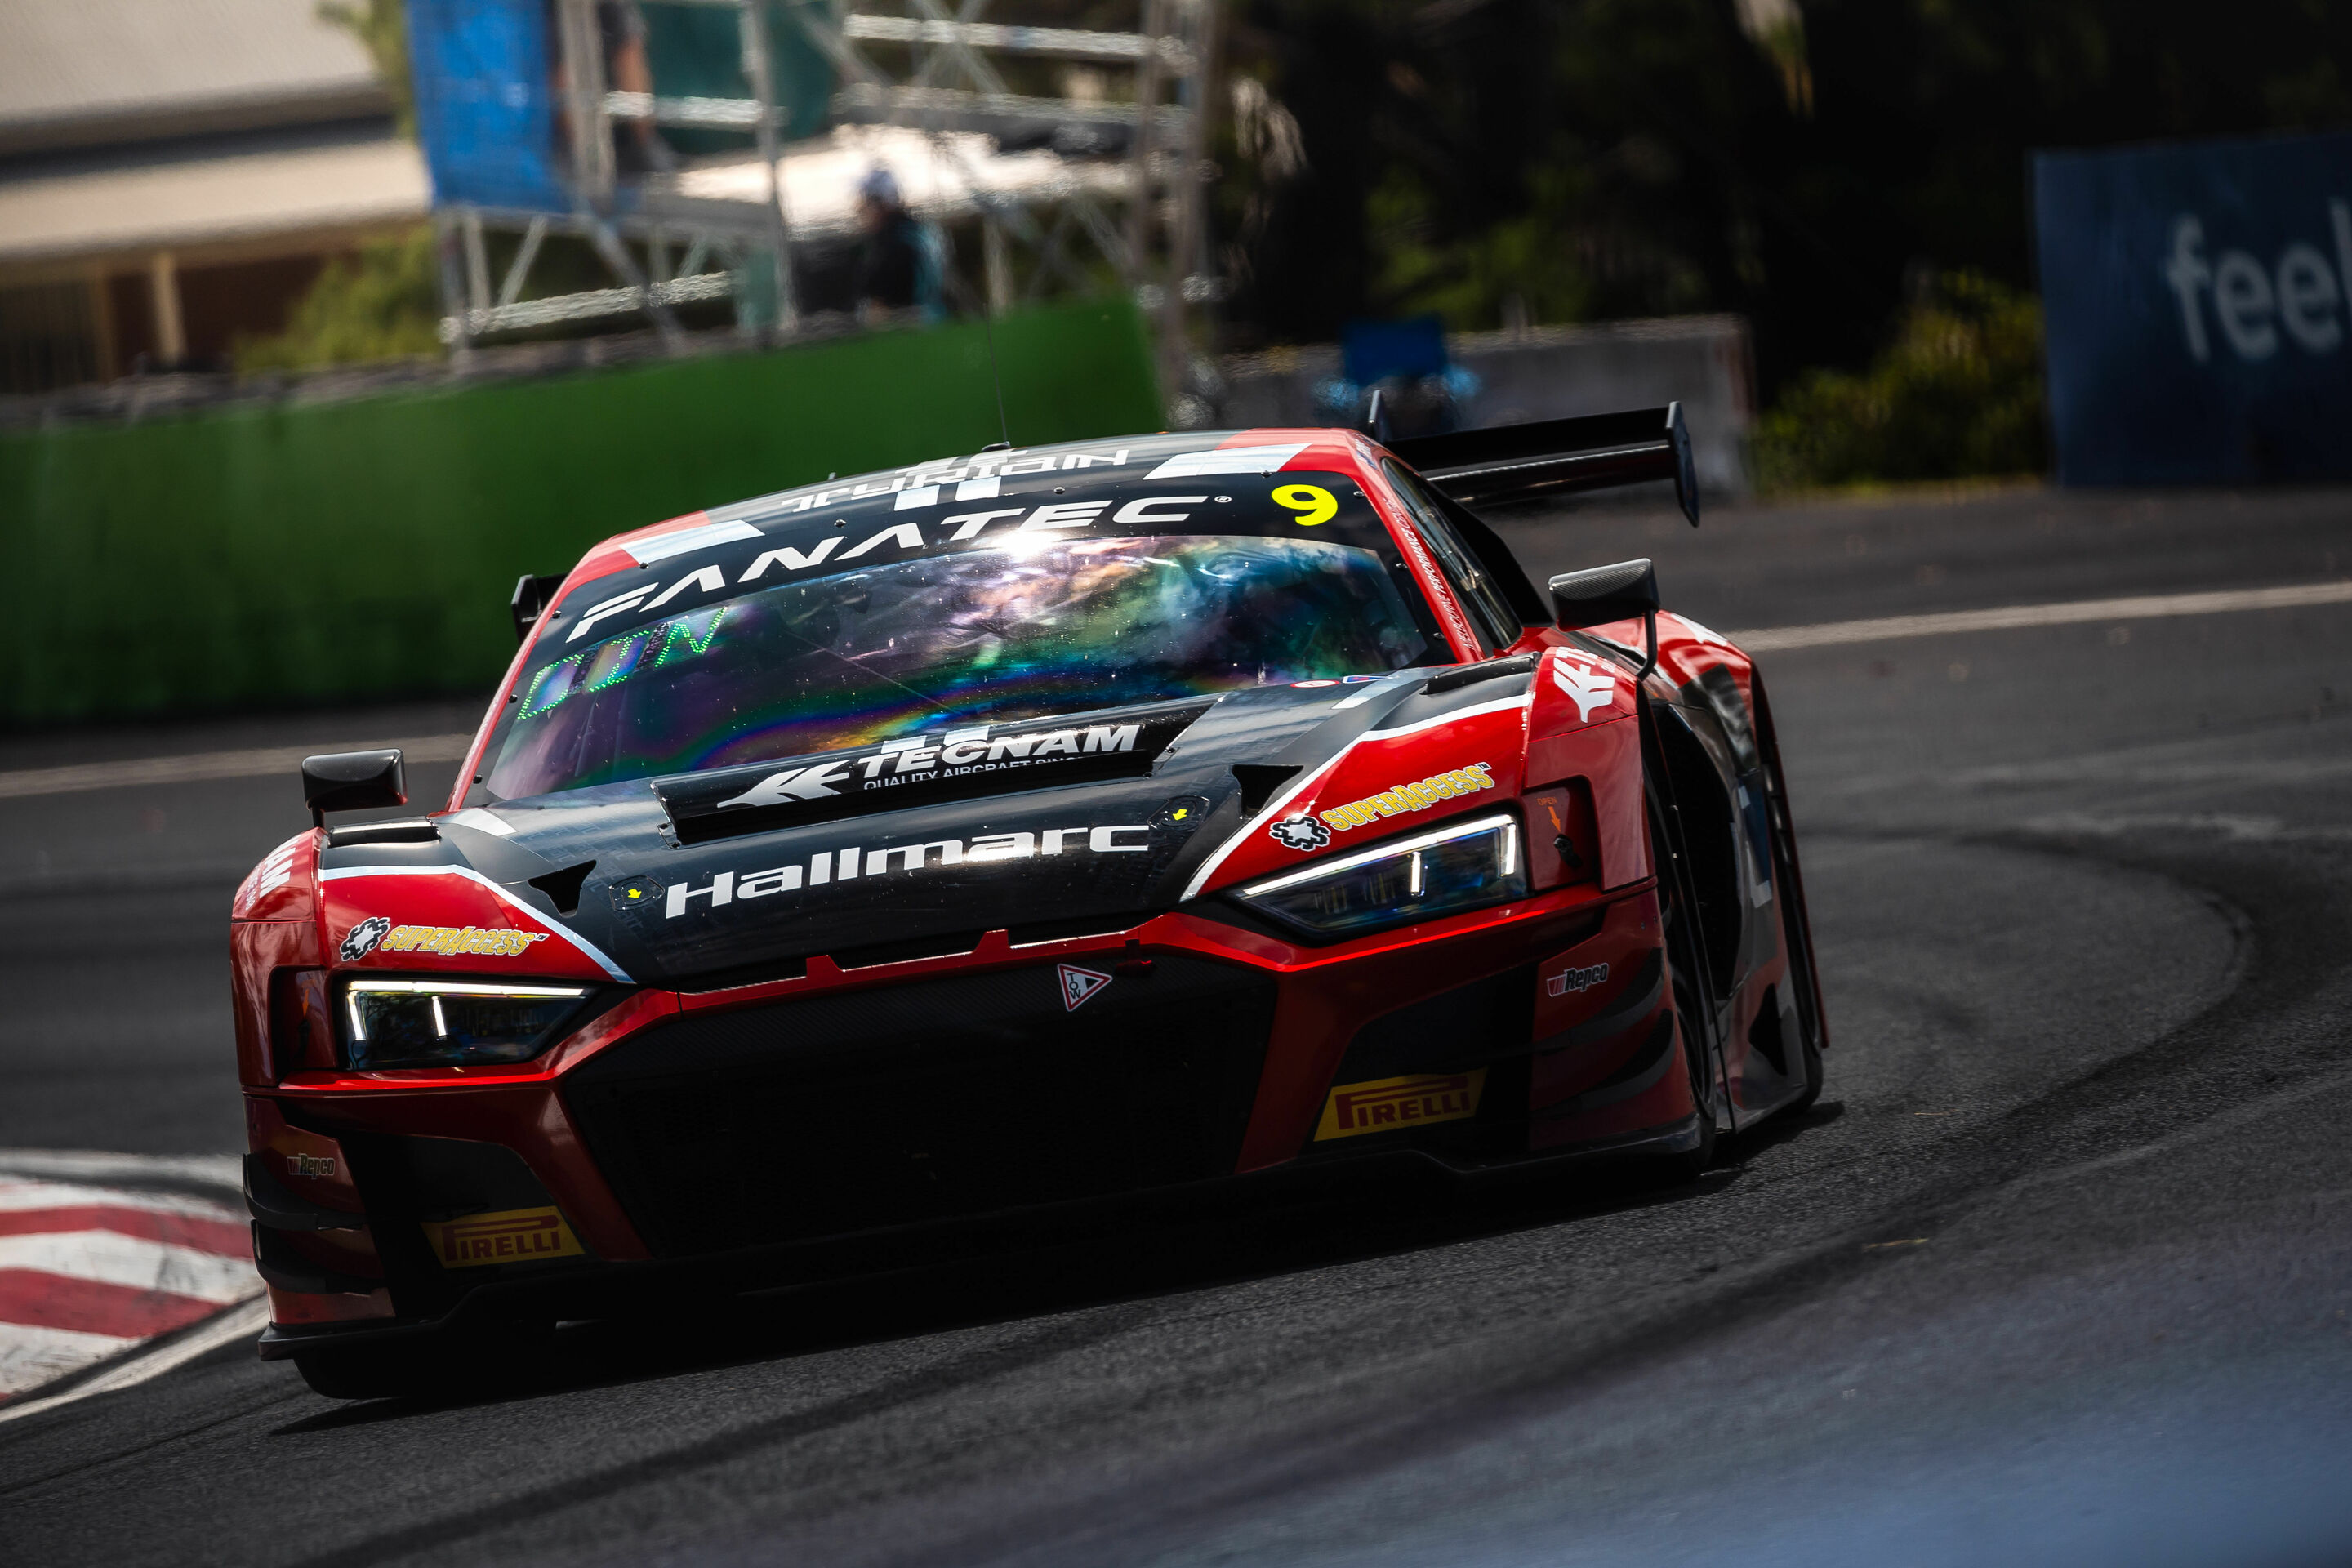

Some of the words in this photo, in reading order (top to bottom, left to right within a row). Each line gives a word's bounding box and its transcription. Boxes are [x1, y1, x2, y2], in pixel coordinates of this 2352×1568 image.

[1271, 483, 1338, 526] 9
[858, 724, 1140, 778] TECNAM
[665, 825, 1149, 919] Hallmarc
[1564, 963, 1609, 992] Repco
[1335, 1075, 1469, 1130] PIRELLI
[299, 1153, 335, 1179] Repco
[442, 1215, 561, 1262] PIRELLI
